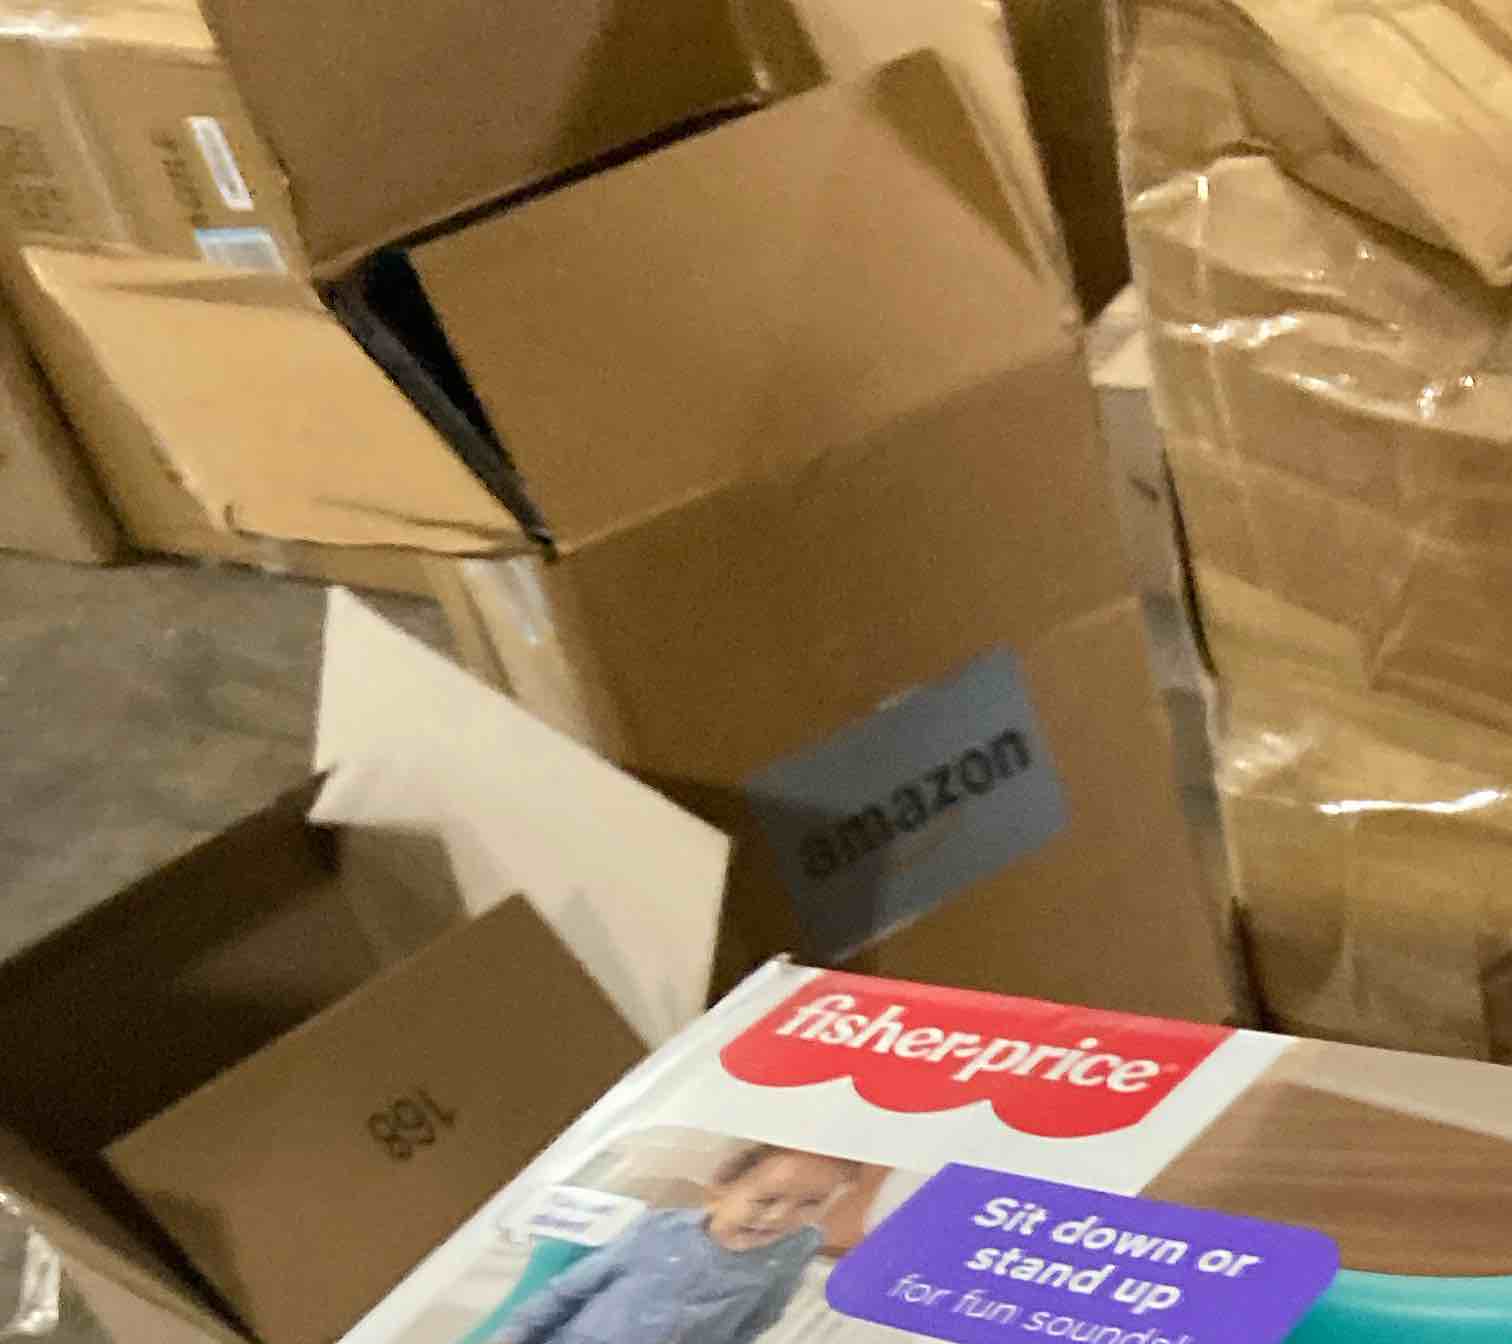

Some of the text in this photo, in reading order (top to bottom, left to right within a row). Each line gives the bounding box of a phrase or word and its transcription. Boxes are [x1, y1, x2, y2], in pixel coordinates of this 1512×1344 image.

[800, 729, 1031, 879] amazon
[775, 994, 1160, 1096] fisher-price
[965, 1242, 1181, 1315] stand up
[974, 1196, 1264, 1280] Sit down or
[887, 1274, 958, 1309] for
[952, 1285, 1017, 1326] fun
